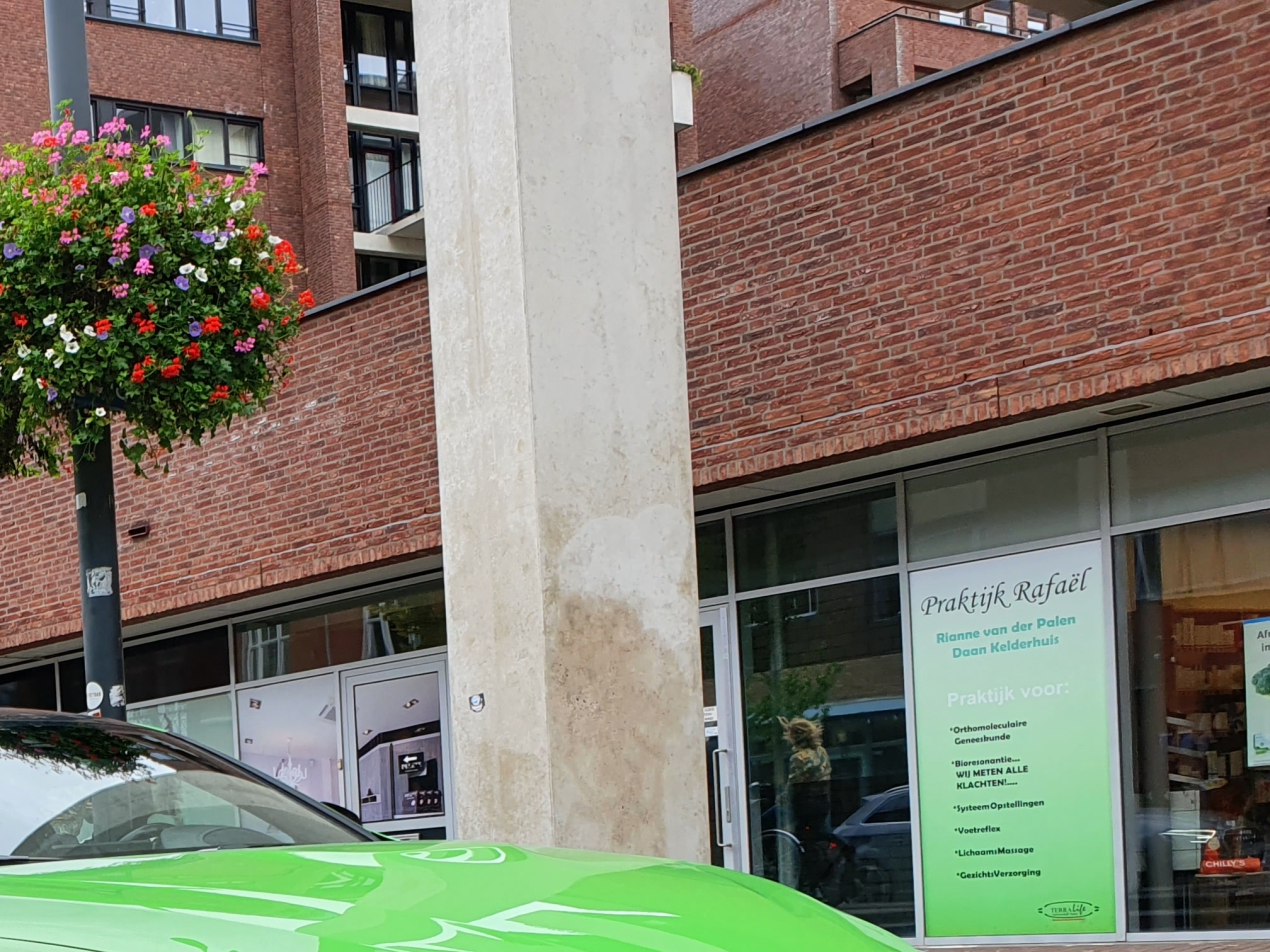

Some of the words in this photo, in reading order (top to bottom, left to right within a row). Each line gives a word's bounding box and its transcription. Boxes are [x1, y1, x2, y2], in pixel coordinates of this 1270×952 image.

[920, 581, 1011, 615] Praktijk
[1013, 567, 1092, 605] Rafaël
[936, 628, 980, 644] Rianne
[983, 625, 1008, 637] van
[1011, 621, 1033, 633] der
[1036, 616, 1076, 629] Palen
[952, 646, 987, 658] Daan
[990, 634, 1060, 653] Kelderhuis
[947, 686, 1015, 707] Praktijk
[1021, 682, 1069, 698] voor:
[954, 733, 1011, 745] Geneeskunde
[956, 770, 971, 778] WIJ
[973, 767, 1003, 777] METEN
[1005, 765, 1029, 774] ALLE
[1205, 860, 1246, 869] CHILLY'S
